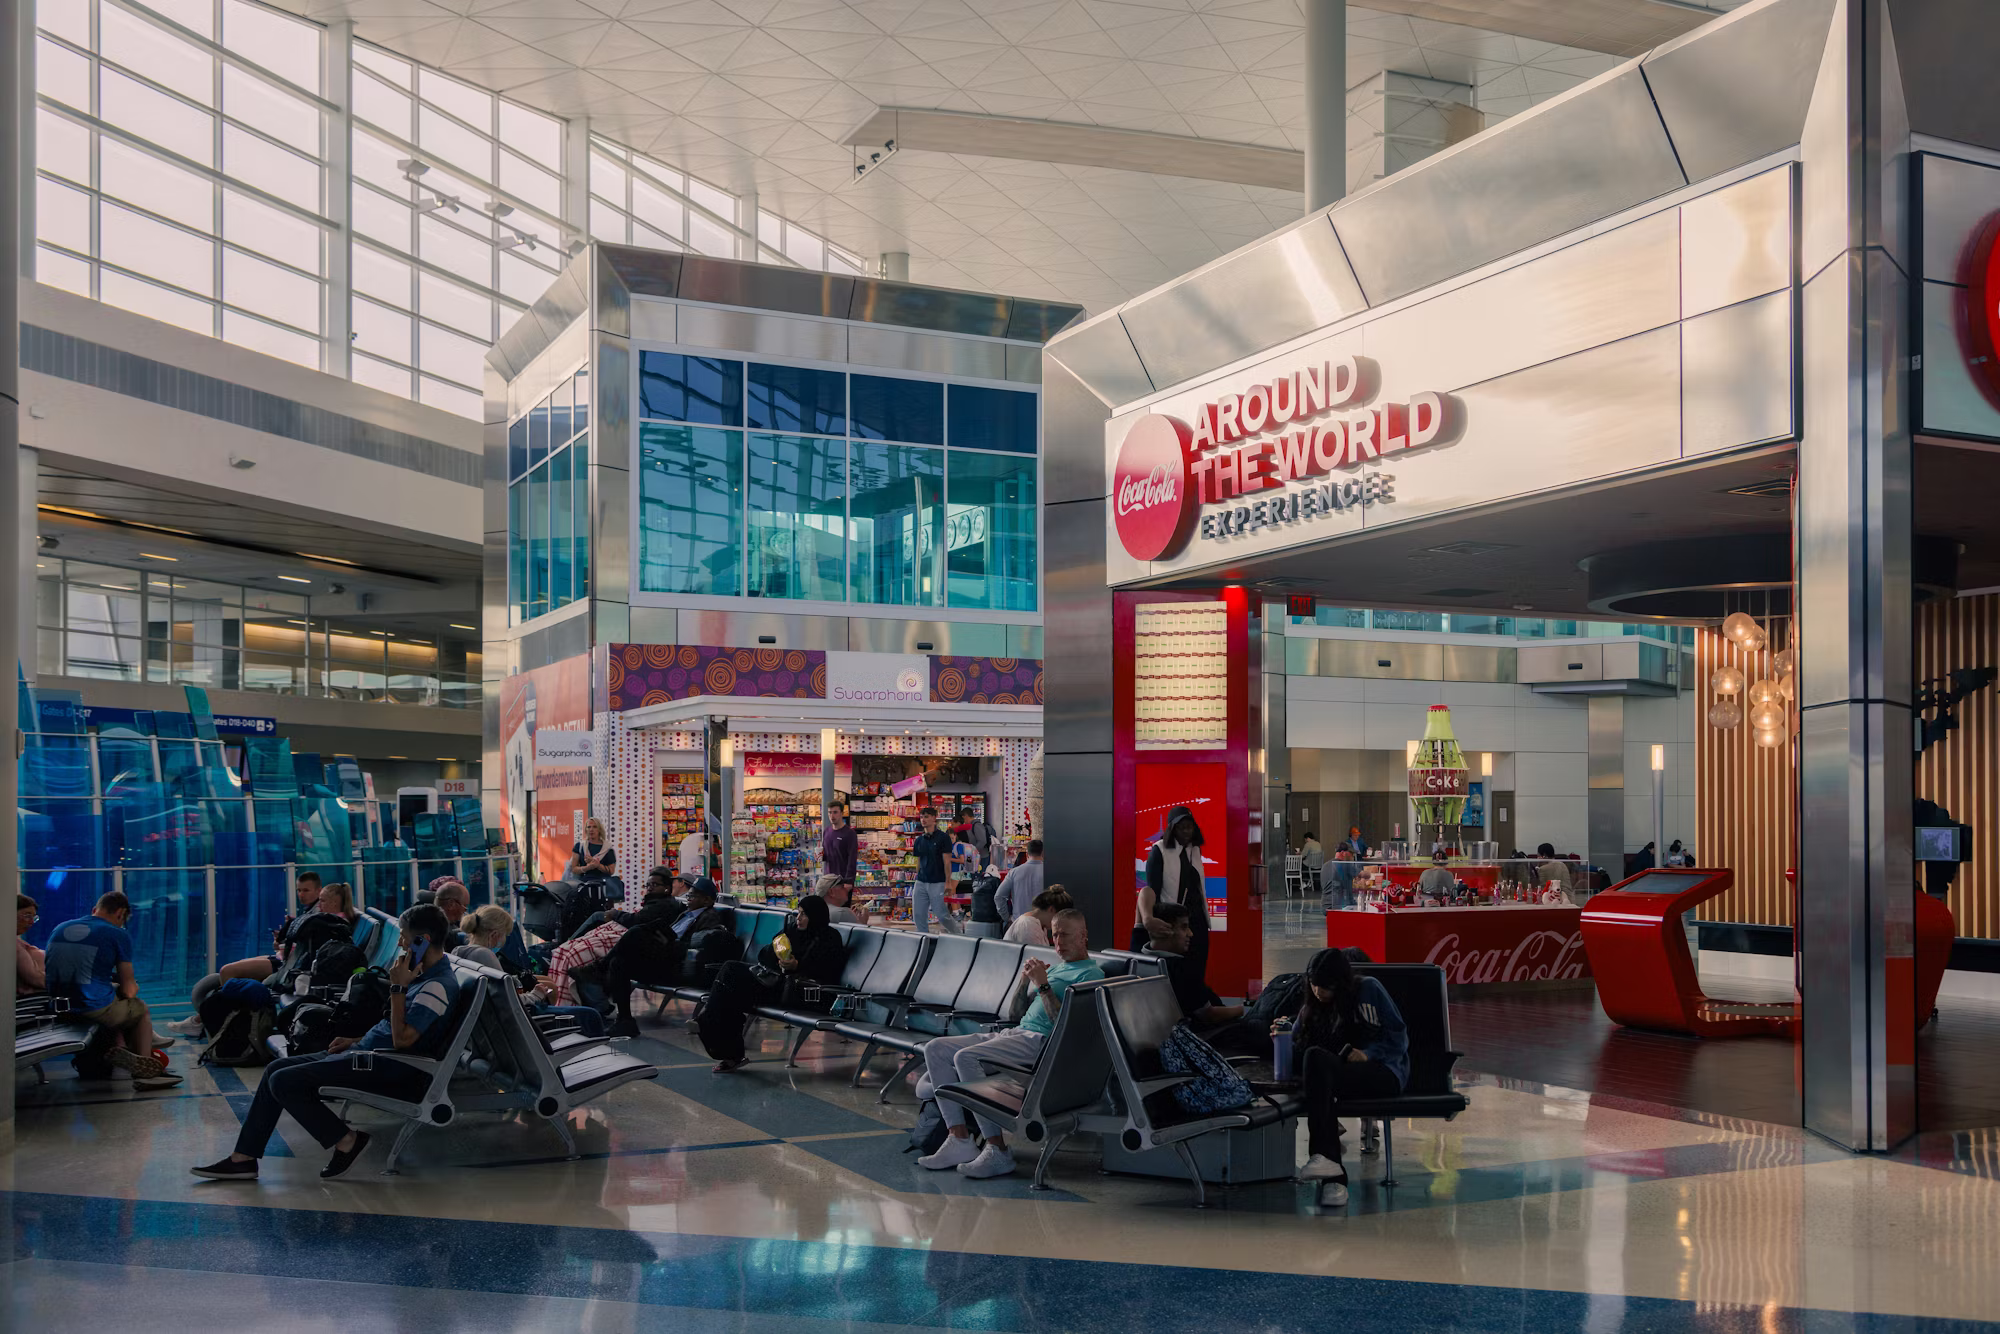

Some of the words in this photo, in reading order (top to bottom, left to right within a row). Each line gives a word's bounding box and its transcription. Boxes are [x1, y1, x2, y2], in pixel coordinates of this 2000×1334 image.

[1191, 355, 1359, 451] AROUND
[1190, 442, 1264, 505] THE
[1274, 391, 1444, 481] WORLD
[1118, 460, 1178, 516] Coca-Cola
[1201, 471, 1388, 541] EXPERIENCE
[1291, 595, 1312, 615] EXIT
[833, 686, 923, 702] Sugarphoria
[213, 718, 228, 726] ates
[747, 757, 778, 768] Find
[779, 763, 796, 774] your
[792, 757, 822, 775] Sugarp
[444, 782, 465, 793] D18
[1426, 775, 1460, 789] Coke
[1423, 930, 1585, 985] Coca-Cola
